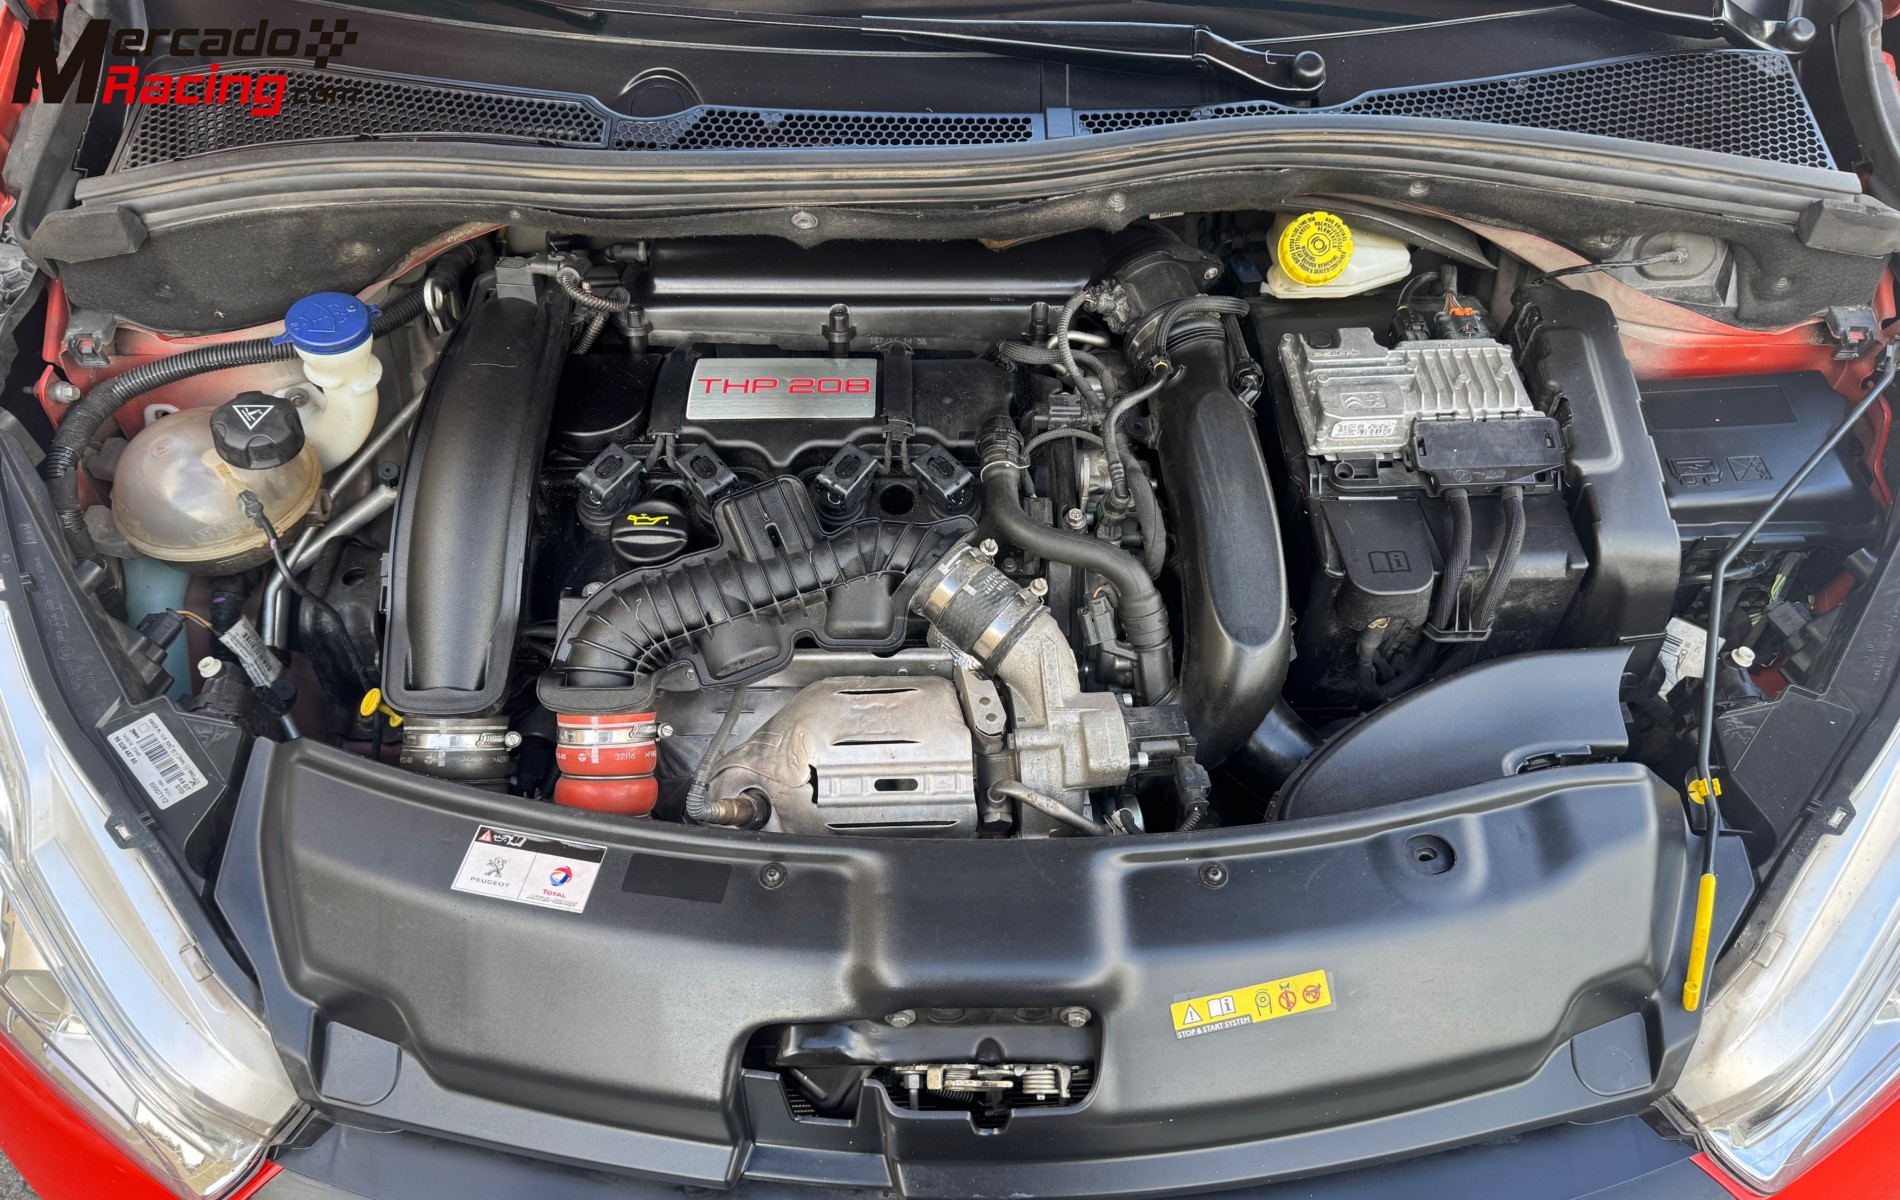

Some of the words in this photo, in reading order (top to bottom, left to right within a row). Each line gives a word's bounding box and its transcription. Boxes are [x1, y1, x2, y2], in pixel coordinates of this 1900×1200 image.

[697, 378, 779, 394] THP
[788, 377, 871, 394] 208
[615, 753, 636, 761] 32/16
[470, 876, 510, 888] PEUGEOT
[542, 888, 567, 899] TOTAL
[1177, 1029, 1196, 1039] STOP
[1202, 1022, 1224, 1033] START
[1225, 1015, 1251, 1029] SYSTEM
